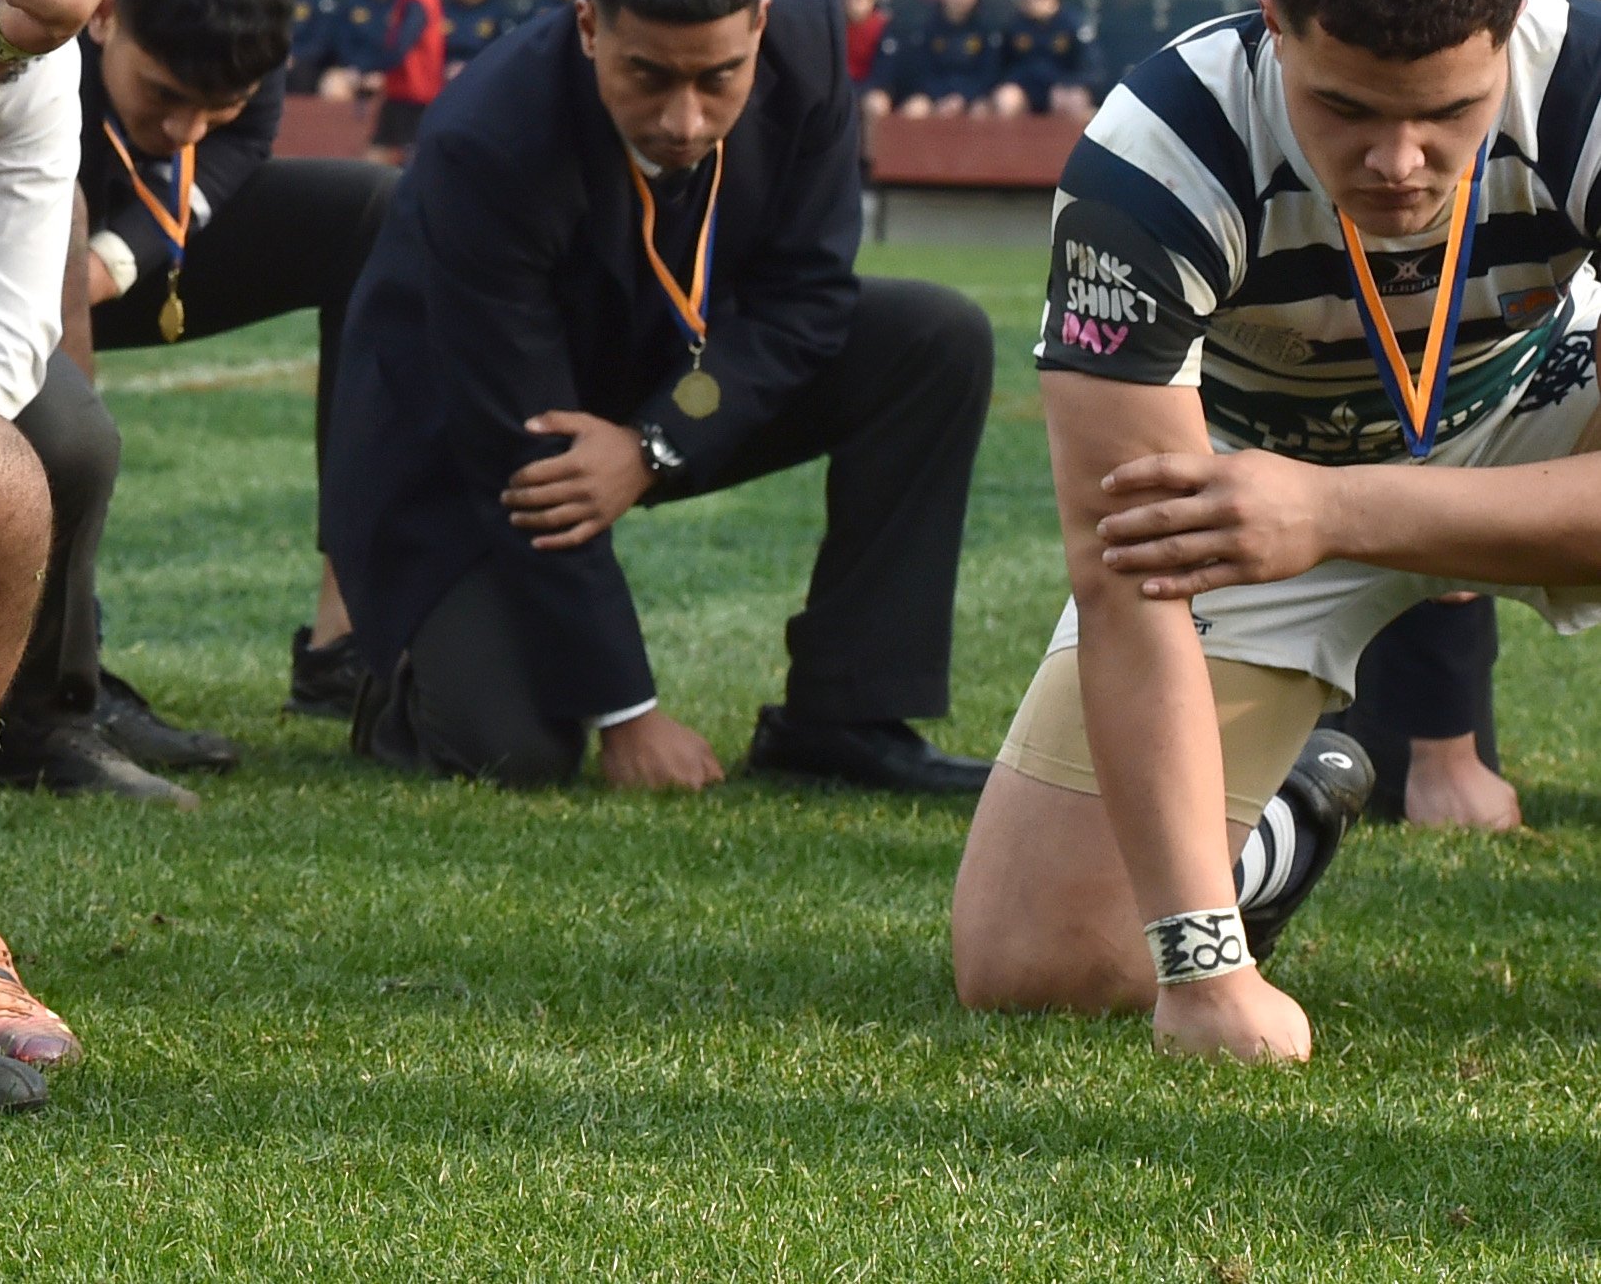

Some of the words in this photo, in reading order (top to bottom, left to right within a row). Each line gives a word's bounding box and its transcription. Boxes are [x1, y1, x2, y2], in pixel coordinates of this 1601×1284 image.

[1065, 238, 1137, 291] PINK
[1066, 277, 1158, 324] SHIRT
[1061, 311, 1129, 356] DAY
